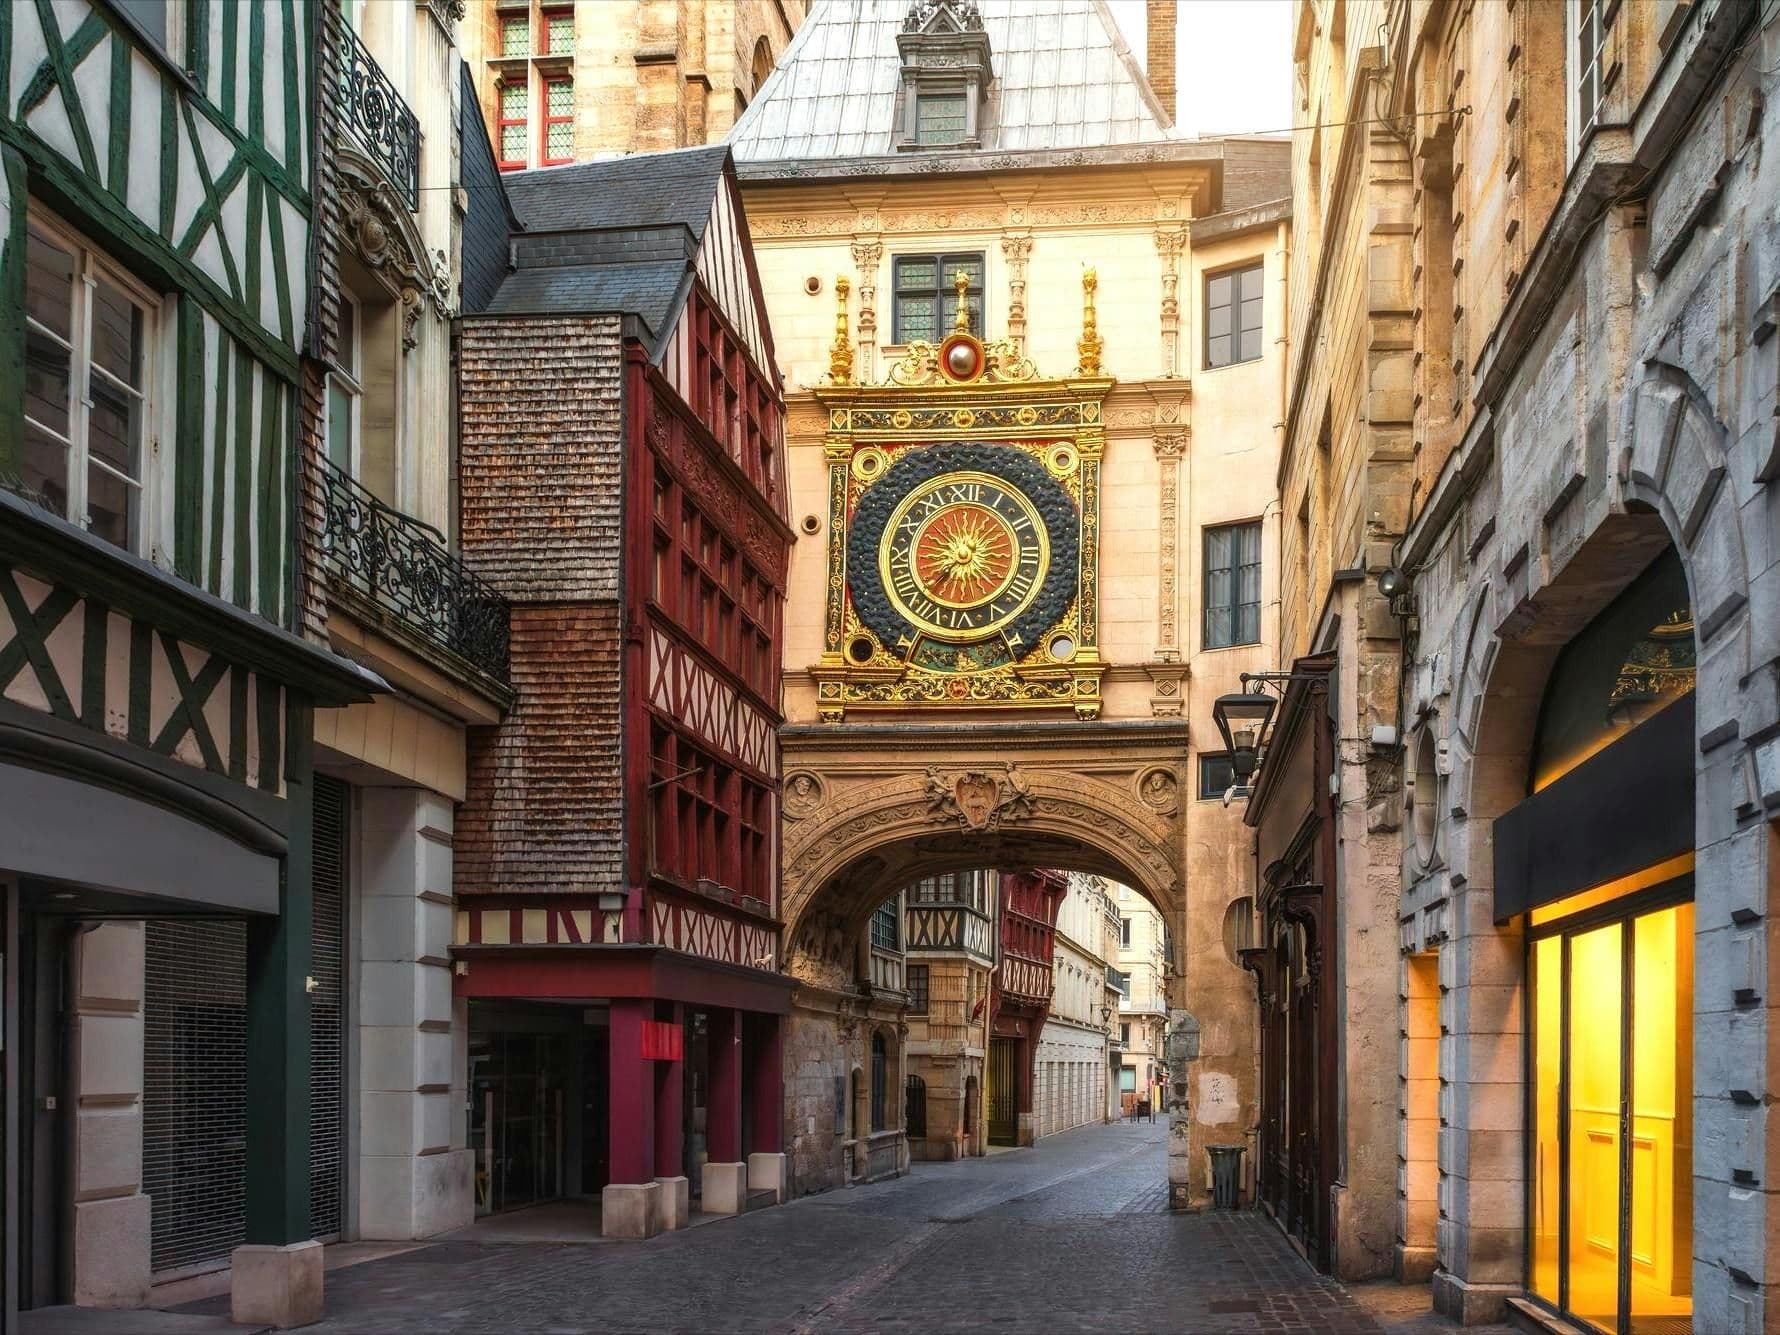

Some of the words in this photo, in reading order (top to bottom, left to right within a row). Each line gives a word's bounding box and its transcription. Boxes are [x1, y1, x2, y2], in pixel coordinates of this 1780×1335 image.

[919, 490, 946, 516] XI
[950, 485, 980, 502] XII
[992, 493, 1004, 508] I
[899, 515, 920, 536] X
[1012, 515, 1032, 532] II
[892, 547, 908, 570] IX
[1021, 546, 1038, 564] III
[894, 572, 919, 608] VIII
[1007, 573, 1033, 601] IIII
[915, 600, 940, 625] VII
[949, 611, 975, 628] VI
[990, 603, 1006, 621] V
